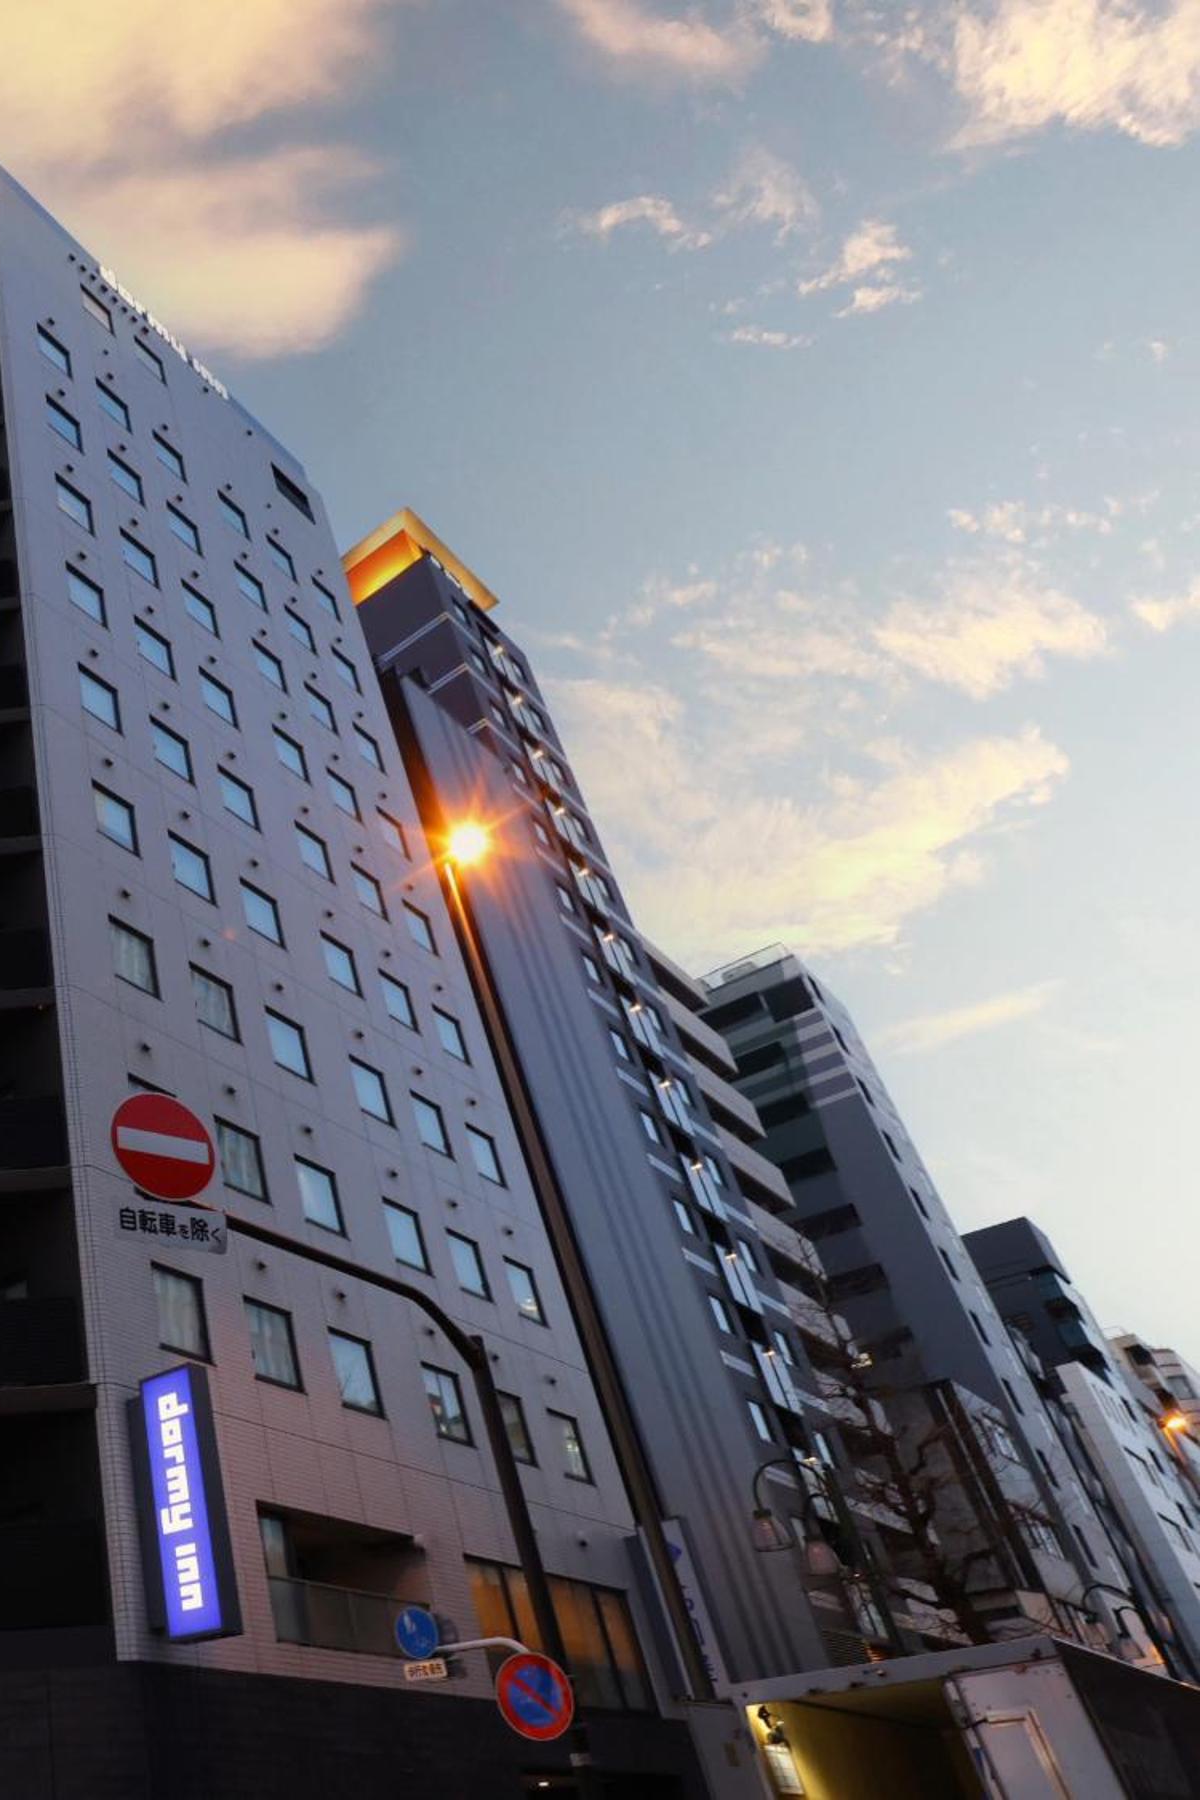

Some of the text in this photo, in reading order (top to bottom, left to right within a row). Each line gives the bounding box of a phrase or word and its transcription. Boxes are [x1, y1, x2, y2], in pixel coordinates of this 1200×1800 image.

[120, 1207, 221, 1242] 自転車を除く
[158, 1392, 203, 1611] dormy inn
